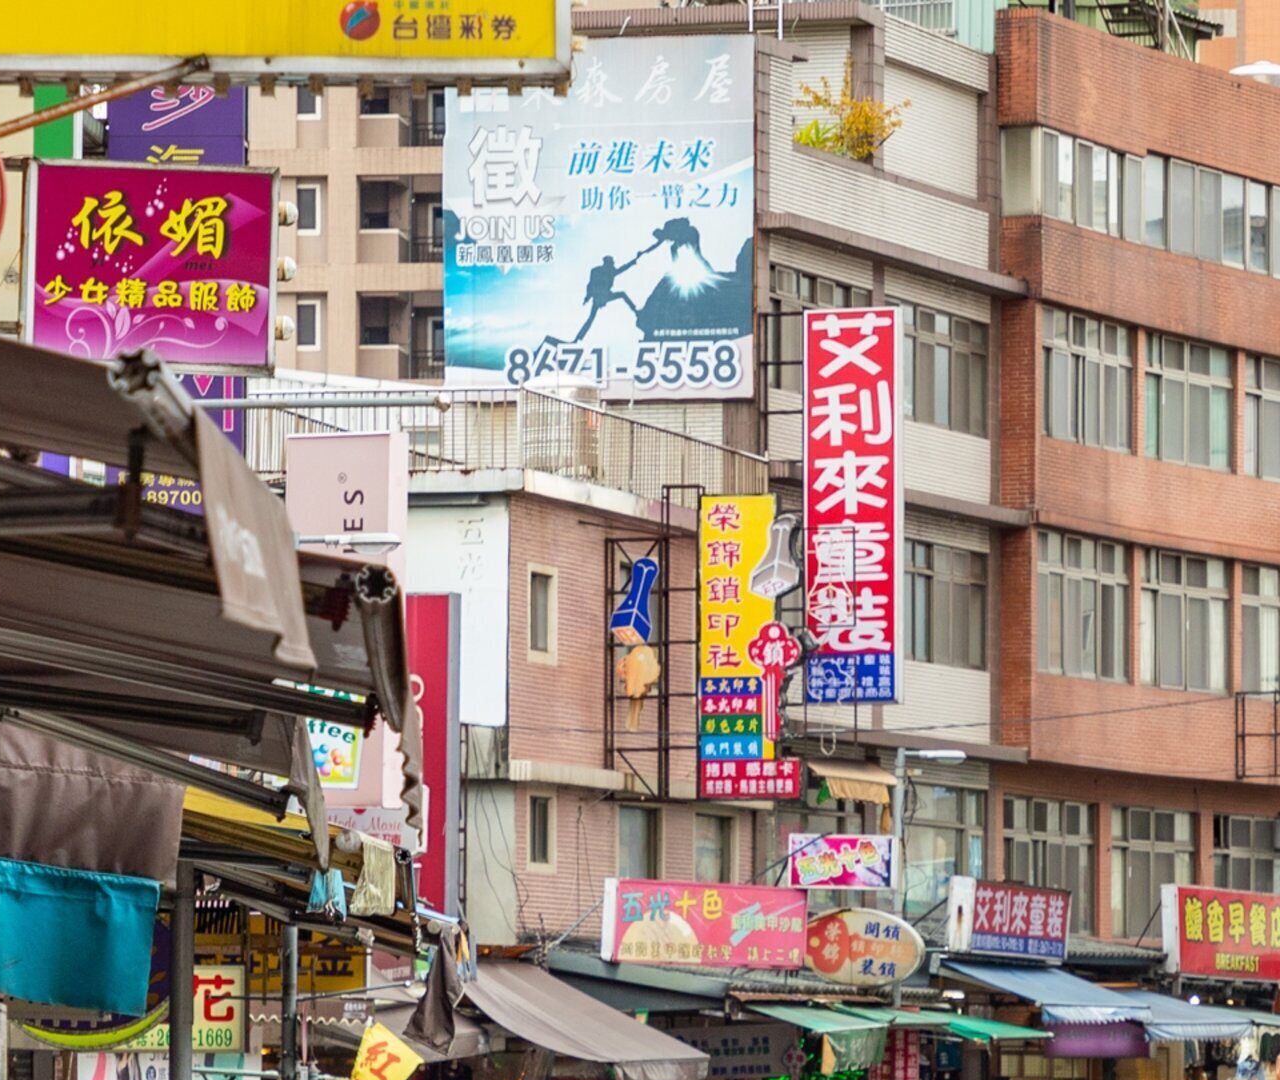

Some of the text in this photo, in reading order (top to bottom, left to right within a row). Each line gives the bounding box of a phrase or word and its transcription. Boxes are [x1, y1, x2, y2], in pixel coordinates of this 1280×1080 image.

[393, 14, 517, 41] 台灣彩券
[521, 54, 735, 108] 森房屋
[468, 124, 543, 208] 徵
[568, 139, 715, 176] 前進未來
[580, 182, 739, 211] 助你一臂之力
[455, 214, 556, 241] JOIN US
[185, 259, 214, 271] mei
[458, 244, 555, 265] 新鳳凰團隊
[42, 274, 257, 313] 少女精品服飾
[506, 344, 738, 386] 8671-5558
[807, 312, 894, 652] 艾利來童裝
[706, 503, 742, 671] 榮錦鎖印社
[622, 888, 723, 923] 五光十色
[974, 886, 1065, 939] 艾利來童裝
[864, 920, 902, 942] 開鎖
[858, 958, 897, 978] 裝鎖
[1214, 952, 1260, 974] BREAKFAST
